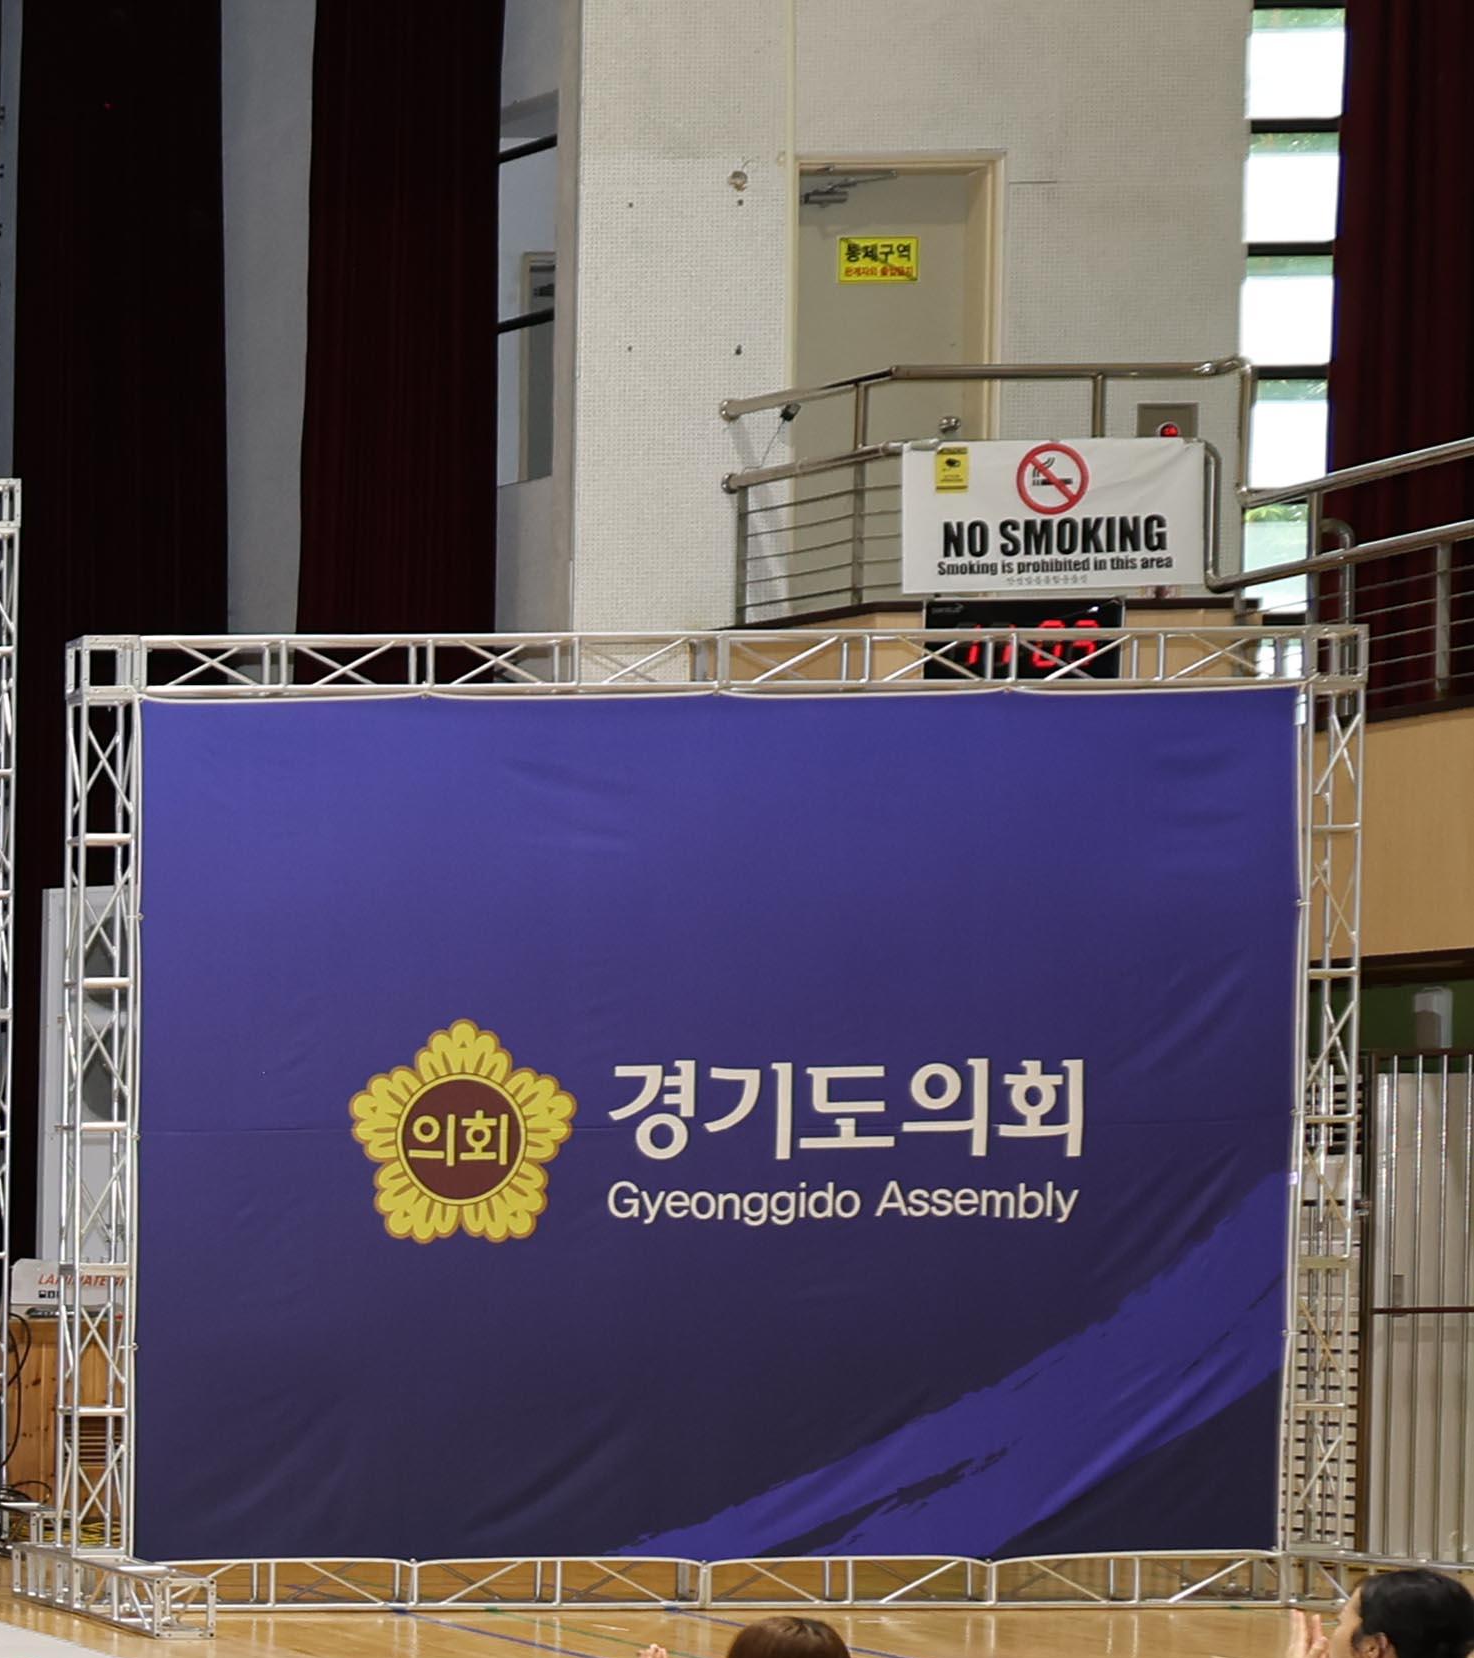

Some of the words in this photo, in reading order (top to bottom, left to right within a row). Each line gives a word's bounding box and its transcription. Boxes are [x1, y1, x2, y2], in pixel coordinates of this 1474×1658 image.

[943, 520, 989, 558] NO
[999, 514, 1168, 556] SMOKING
[937, 560, 998, 576] Smoking
[1001, 560, 1014, 574] is
[1017, 556, 1090, 574] prohibited
[1094, 557, 1106, 570] in
[1110, 555, 1137, 570] this
[1141, 555, 1173, 569] area
[608, 1058, 1083, 1160] 경기도의회
[408, 1109, 509, 1167] 의회
[608, 1181, 861, 1226] Gyeonggido
[875, 1181, 1079, 1224] Assembly
